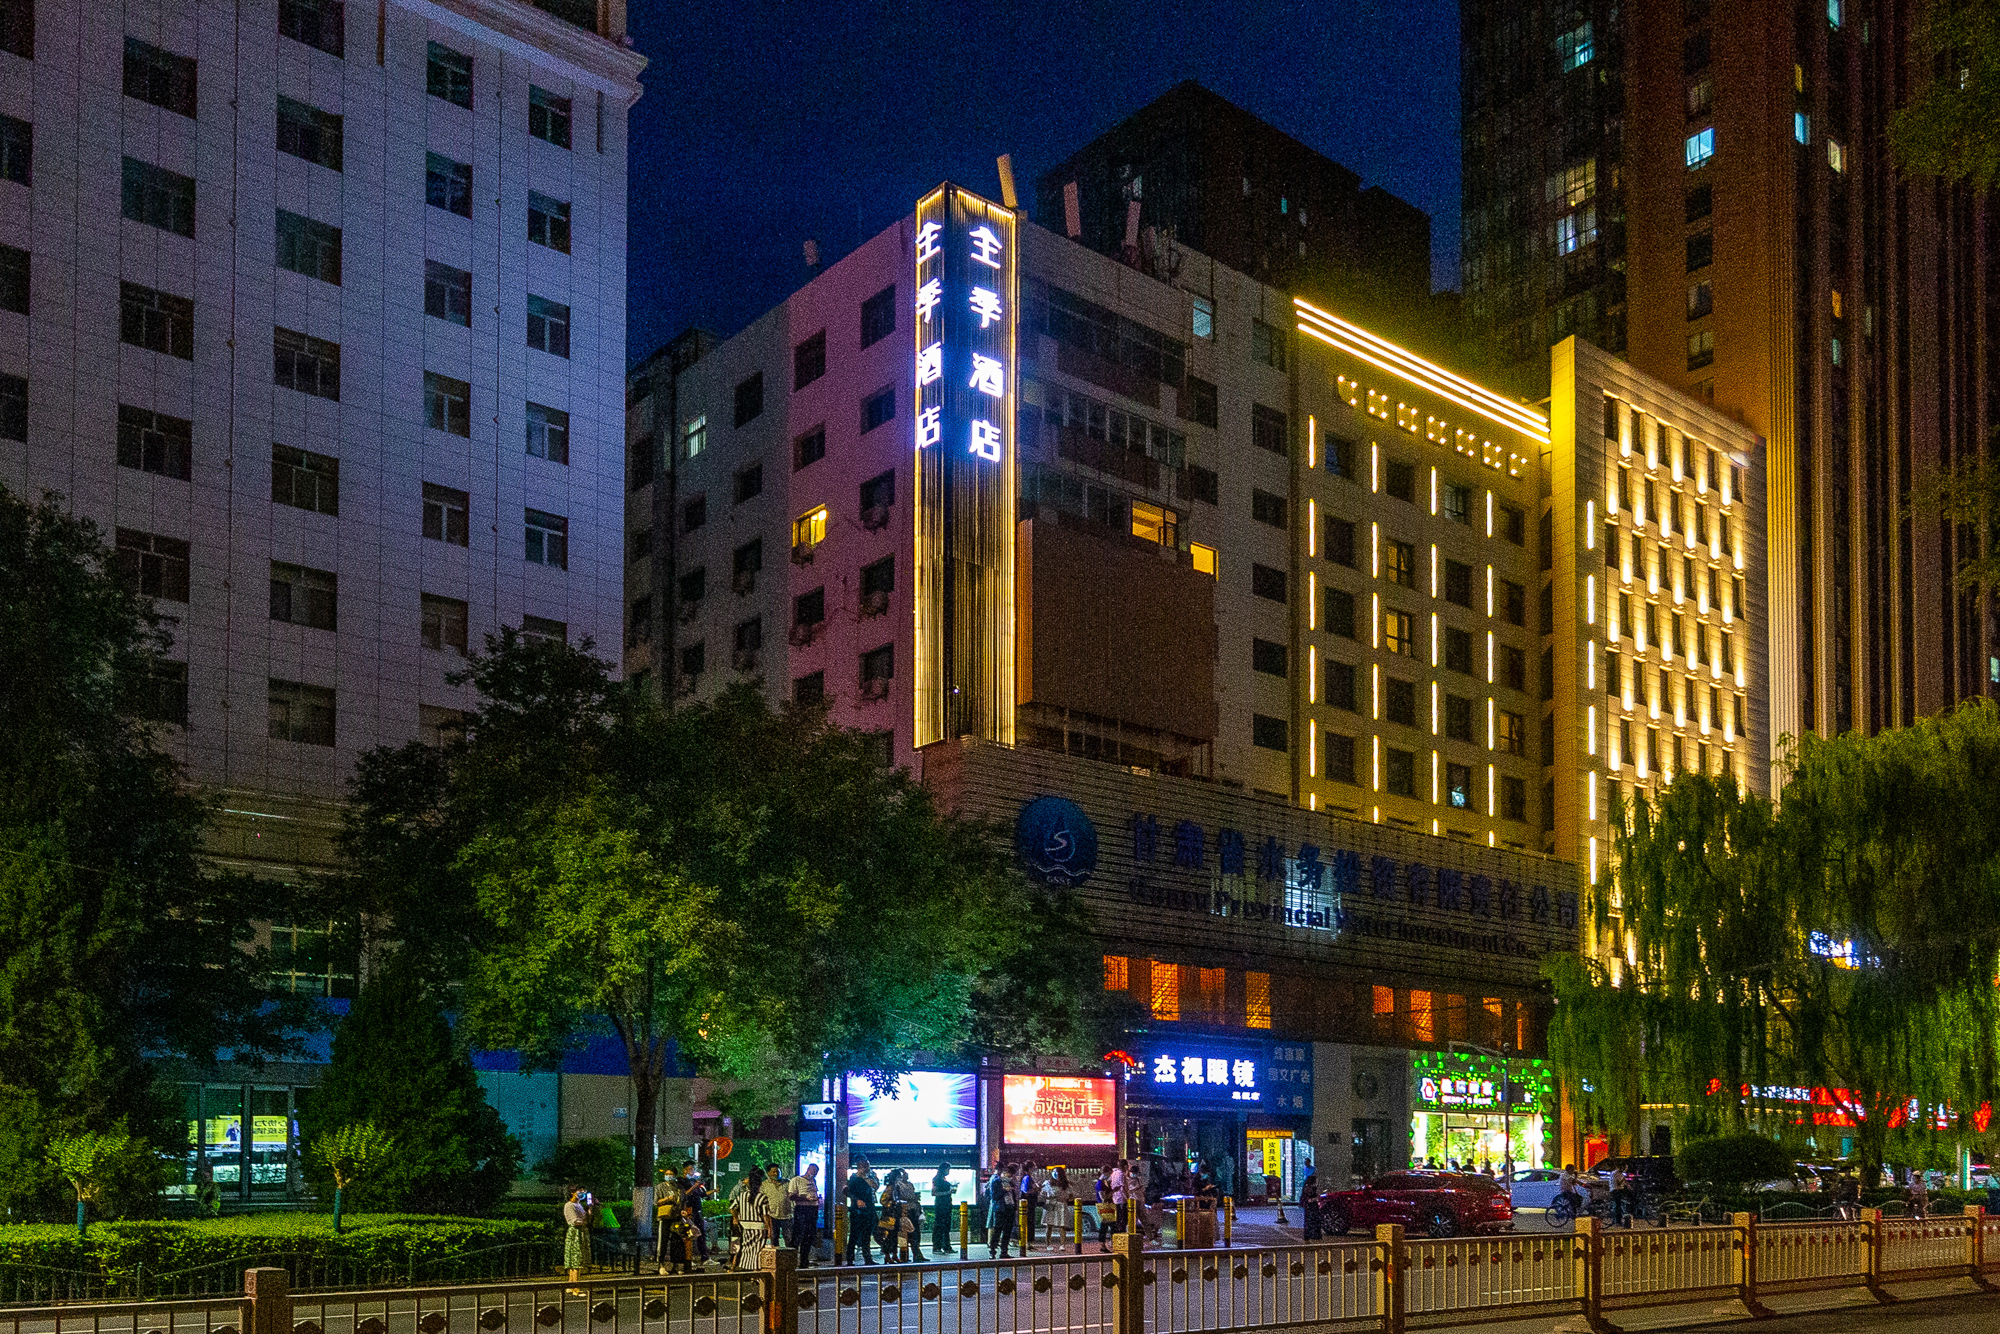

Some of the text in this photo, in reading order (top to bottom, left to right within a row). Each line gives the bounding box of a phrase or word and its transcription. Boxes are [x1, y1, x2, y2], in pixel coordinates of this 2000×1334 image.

[915, 221, 943, 450] 全季酒店
[969, 225, 1004, 463] 全季酒店
[1215, 889, 1331, 928] Provincial
[1154, 1054, 1257, 1088] 杰视眼镜
